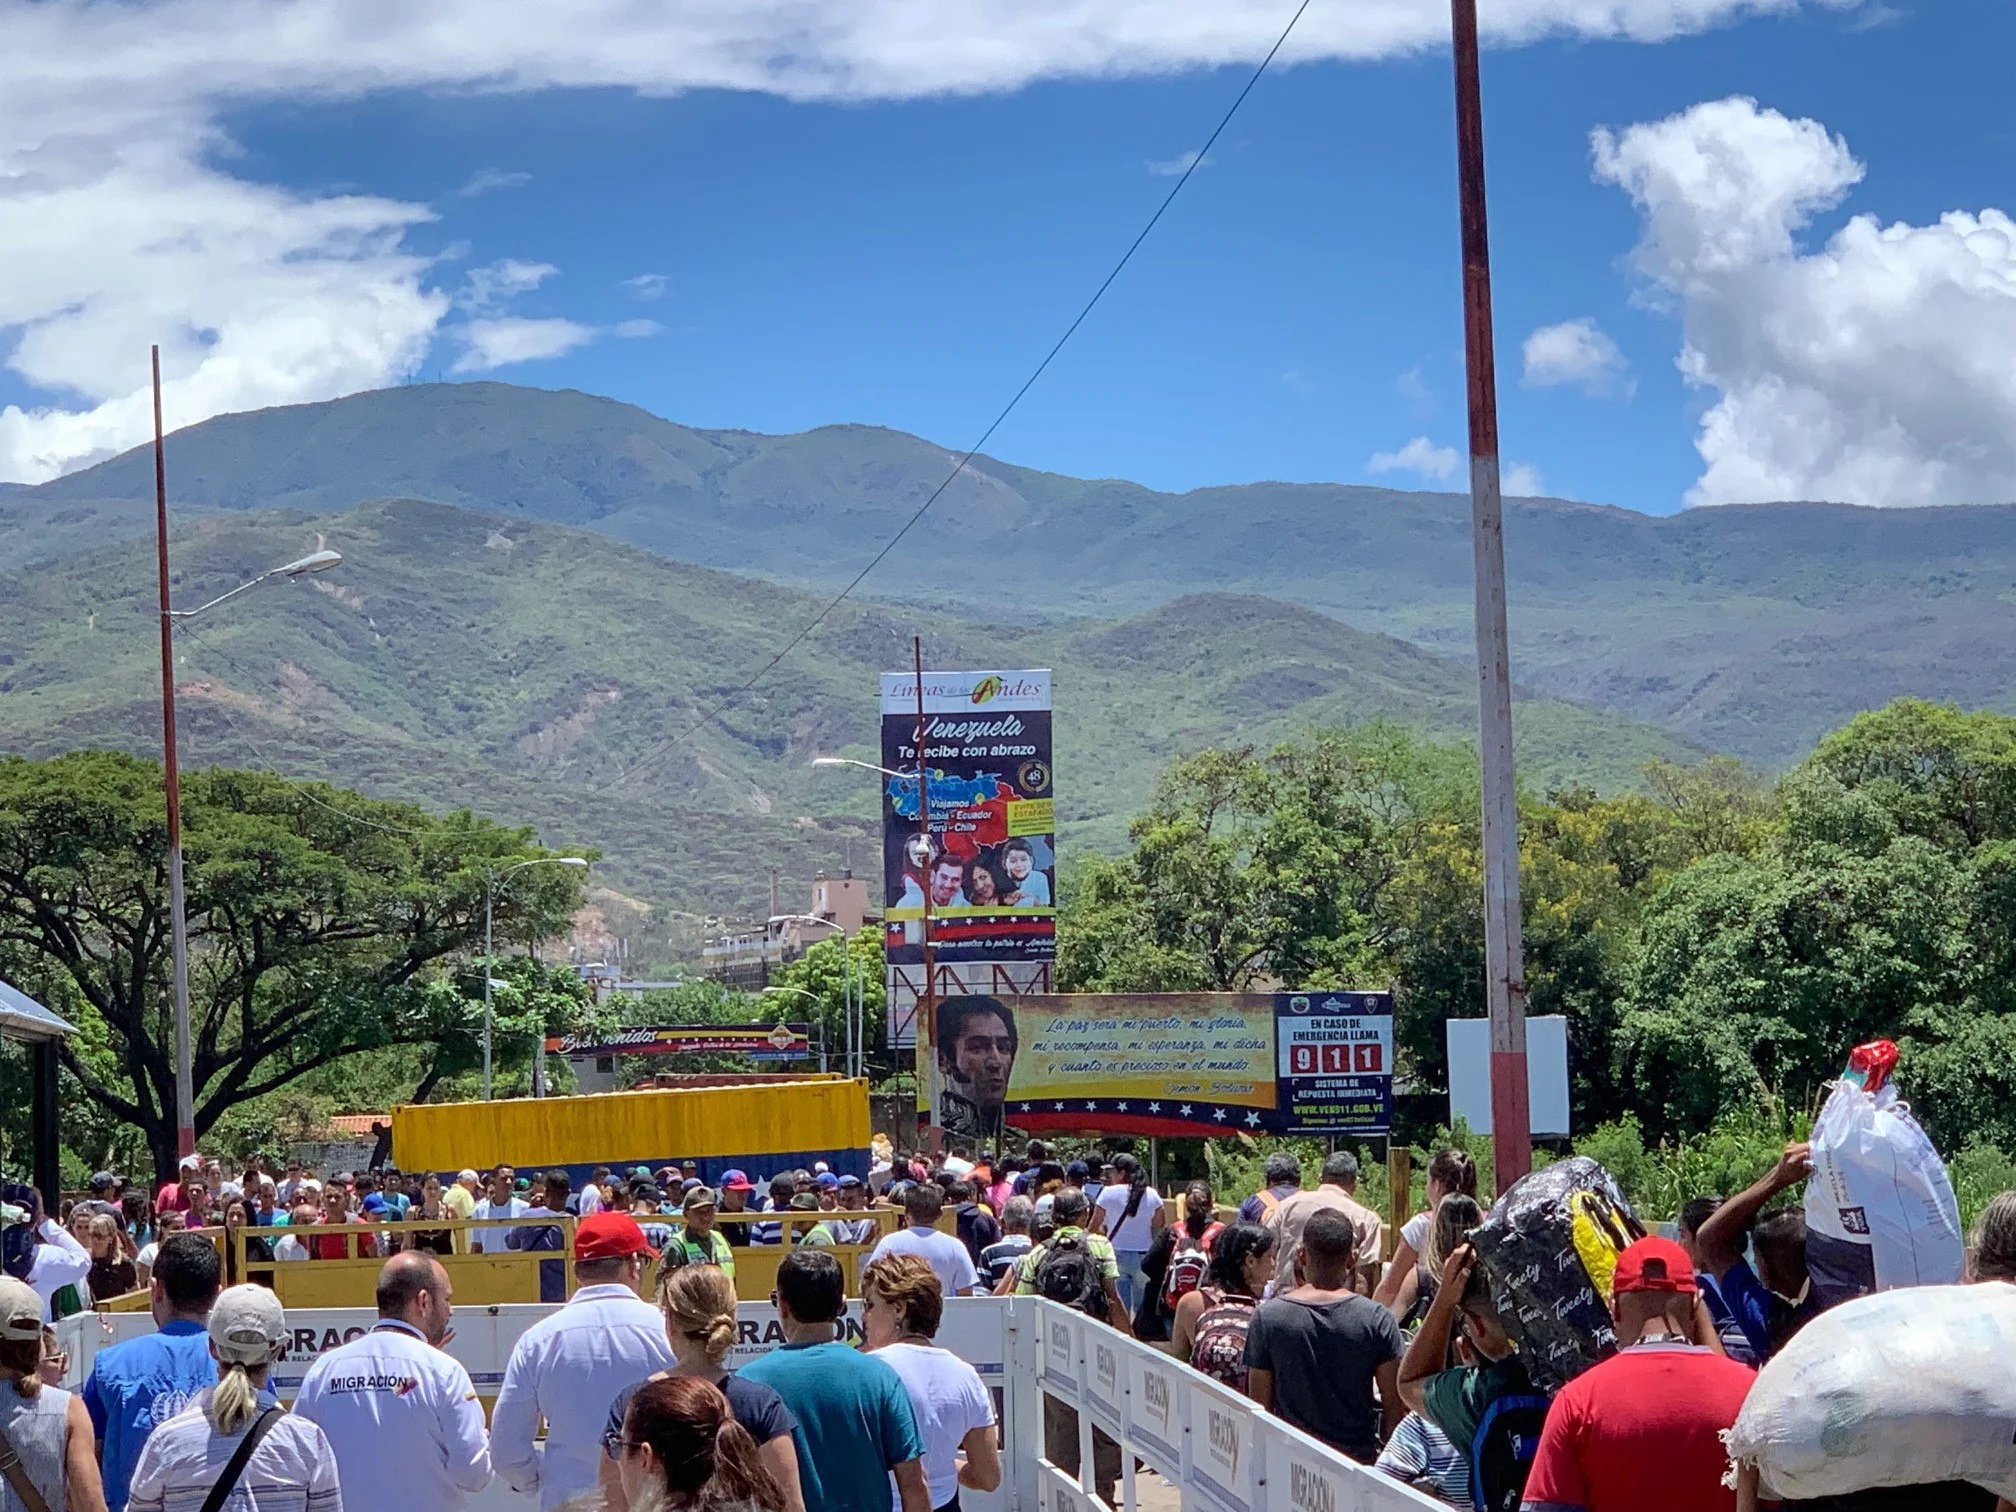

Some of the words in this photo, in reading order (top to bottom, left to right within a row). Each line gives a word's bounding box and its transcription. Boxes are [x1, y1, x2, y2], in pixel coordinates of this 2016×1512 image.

[972, 679, 1042, 704] Andes
[912, 714, 1026, 743] Venezuela
[898, 746, 914, 759] Te
[962, 747, 987, 757] con
[990, 744, 1036, 756] abrazo
[931, 800, 970, 810] Viajamos
[908, 811, 950, 822] Combia
[956, 810, 992, 820] Ecuador
[954, 822, 977, 832] Chile
[1046, 1018, 1064, 1033] La
[1065, 1020, 1090, 1034] paz
[1121, 1019, 1138, 1029] mi
[1189, 1019, 1204, 1029] mi
[1311, 1019, 1322, 1029] EN
[1324, 1019, 1348, 1029] CASO
[1350, 1018, 1361, 1028] DE
[555, 1028, 658, 1054] Bievenidos
[1293, 1031, 1349, 1041] EMERGENCIA
[1350, 1030, 1379, 1040] LLAMA
[1032, 1040, 1050, 1051] mi
[1127, 1039, 1145, 1051] mi
[1213, 1038, 1230, 1050] mi
[1233, 1037, 1266, 1050] dicha
[1047, 1062, 1057, 1075] y
[1060, 1060, 1102, 1072] cuanto
[1106, 1062, 1118, 1072] es
[1119, 1060, 1170, 1075] precioso
[1173, 1061, 1186, 1071] en
[1192, 1058, 1206, 1071] el
[1315, 1079, 1348, 1088] SISTEMA
[1349, 1079, 1360, 1087] DE
[1337, 1088, 1377, 1098] INMEDIATA
[1551, 1286, 1594, 1320] Tweety
[734, 1347, 774, 1355] RELACION
[330, 1372, 407, 1391] MIGRACIÓN
